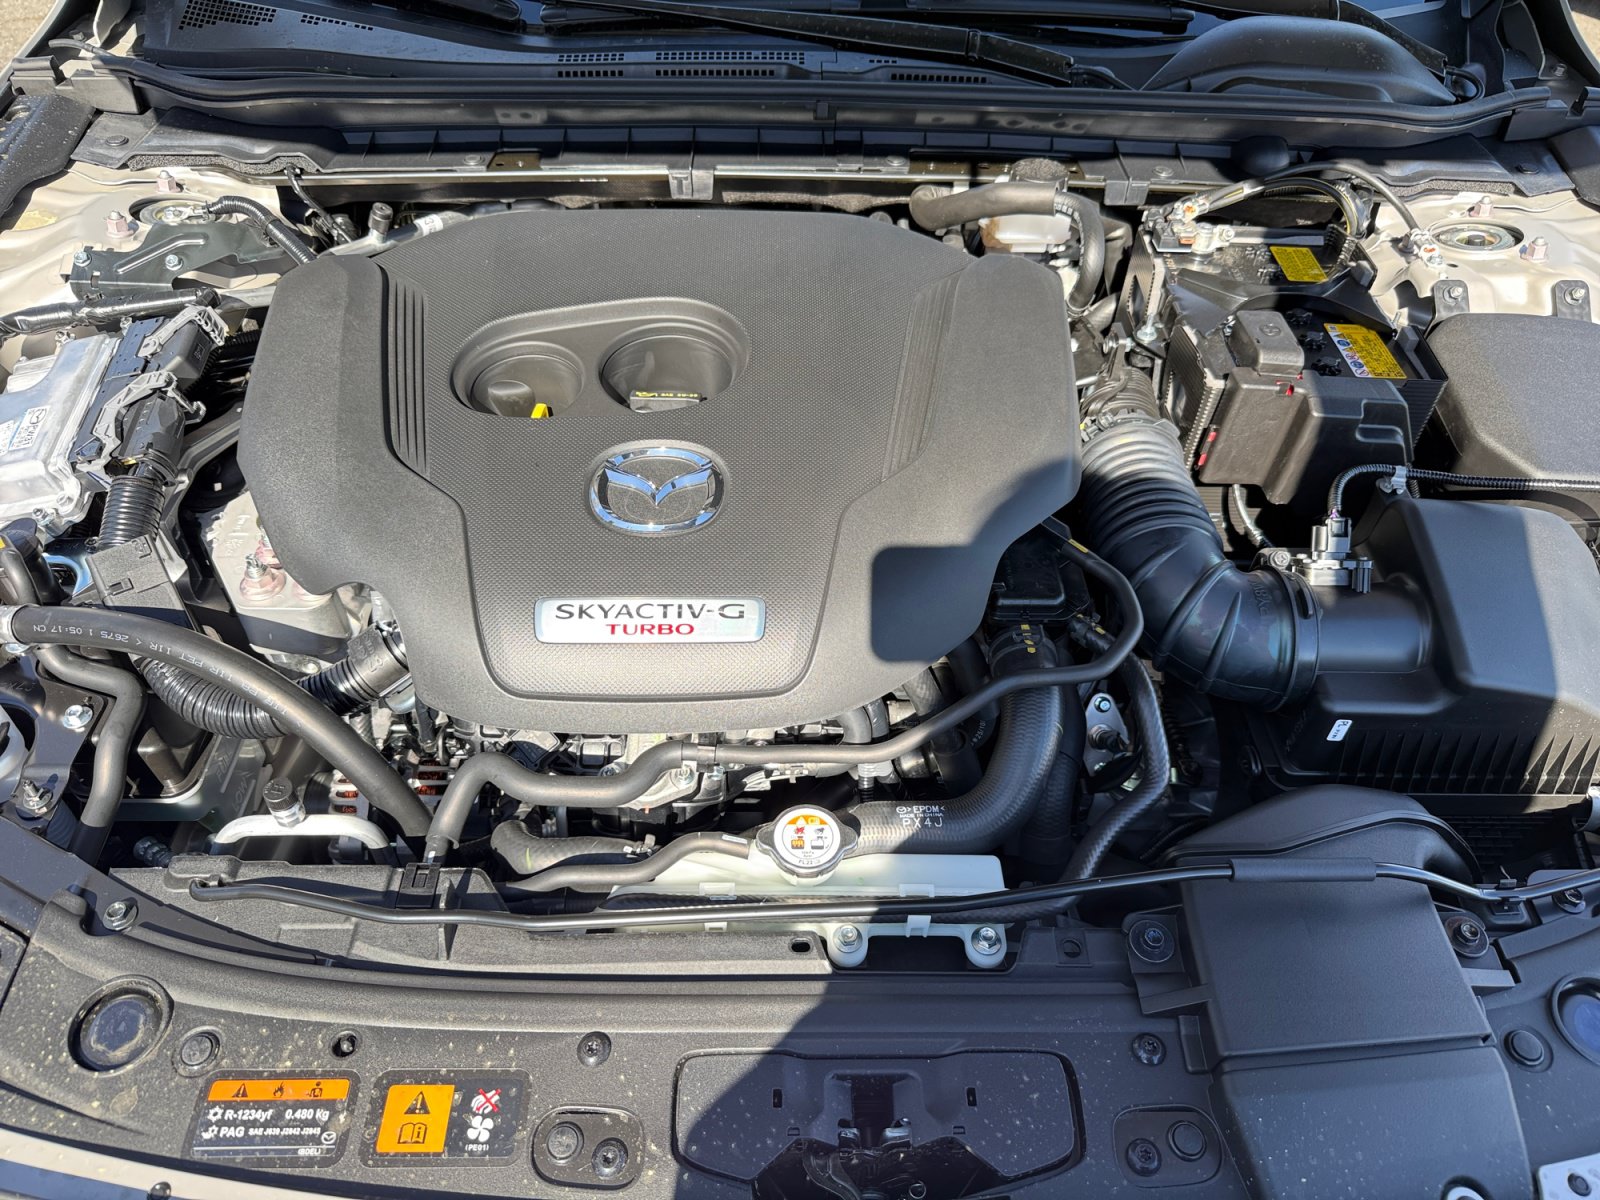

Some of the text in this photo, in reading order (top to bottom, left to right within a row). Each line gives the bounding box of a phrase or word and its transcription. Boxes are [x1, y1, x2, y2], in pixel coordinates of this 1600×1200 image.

[555, 603, 745, 620] SKYACTIV-G
[605, 623, 695, 636] TURBO
[100, 630, 129, 643] 2675
[223, 1108, 330, 1122] R-1234yf 0.480 Kg
[219, 1126, 246, 1138] PAG
[248, 1127, 264, 1136] SAE
